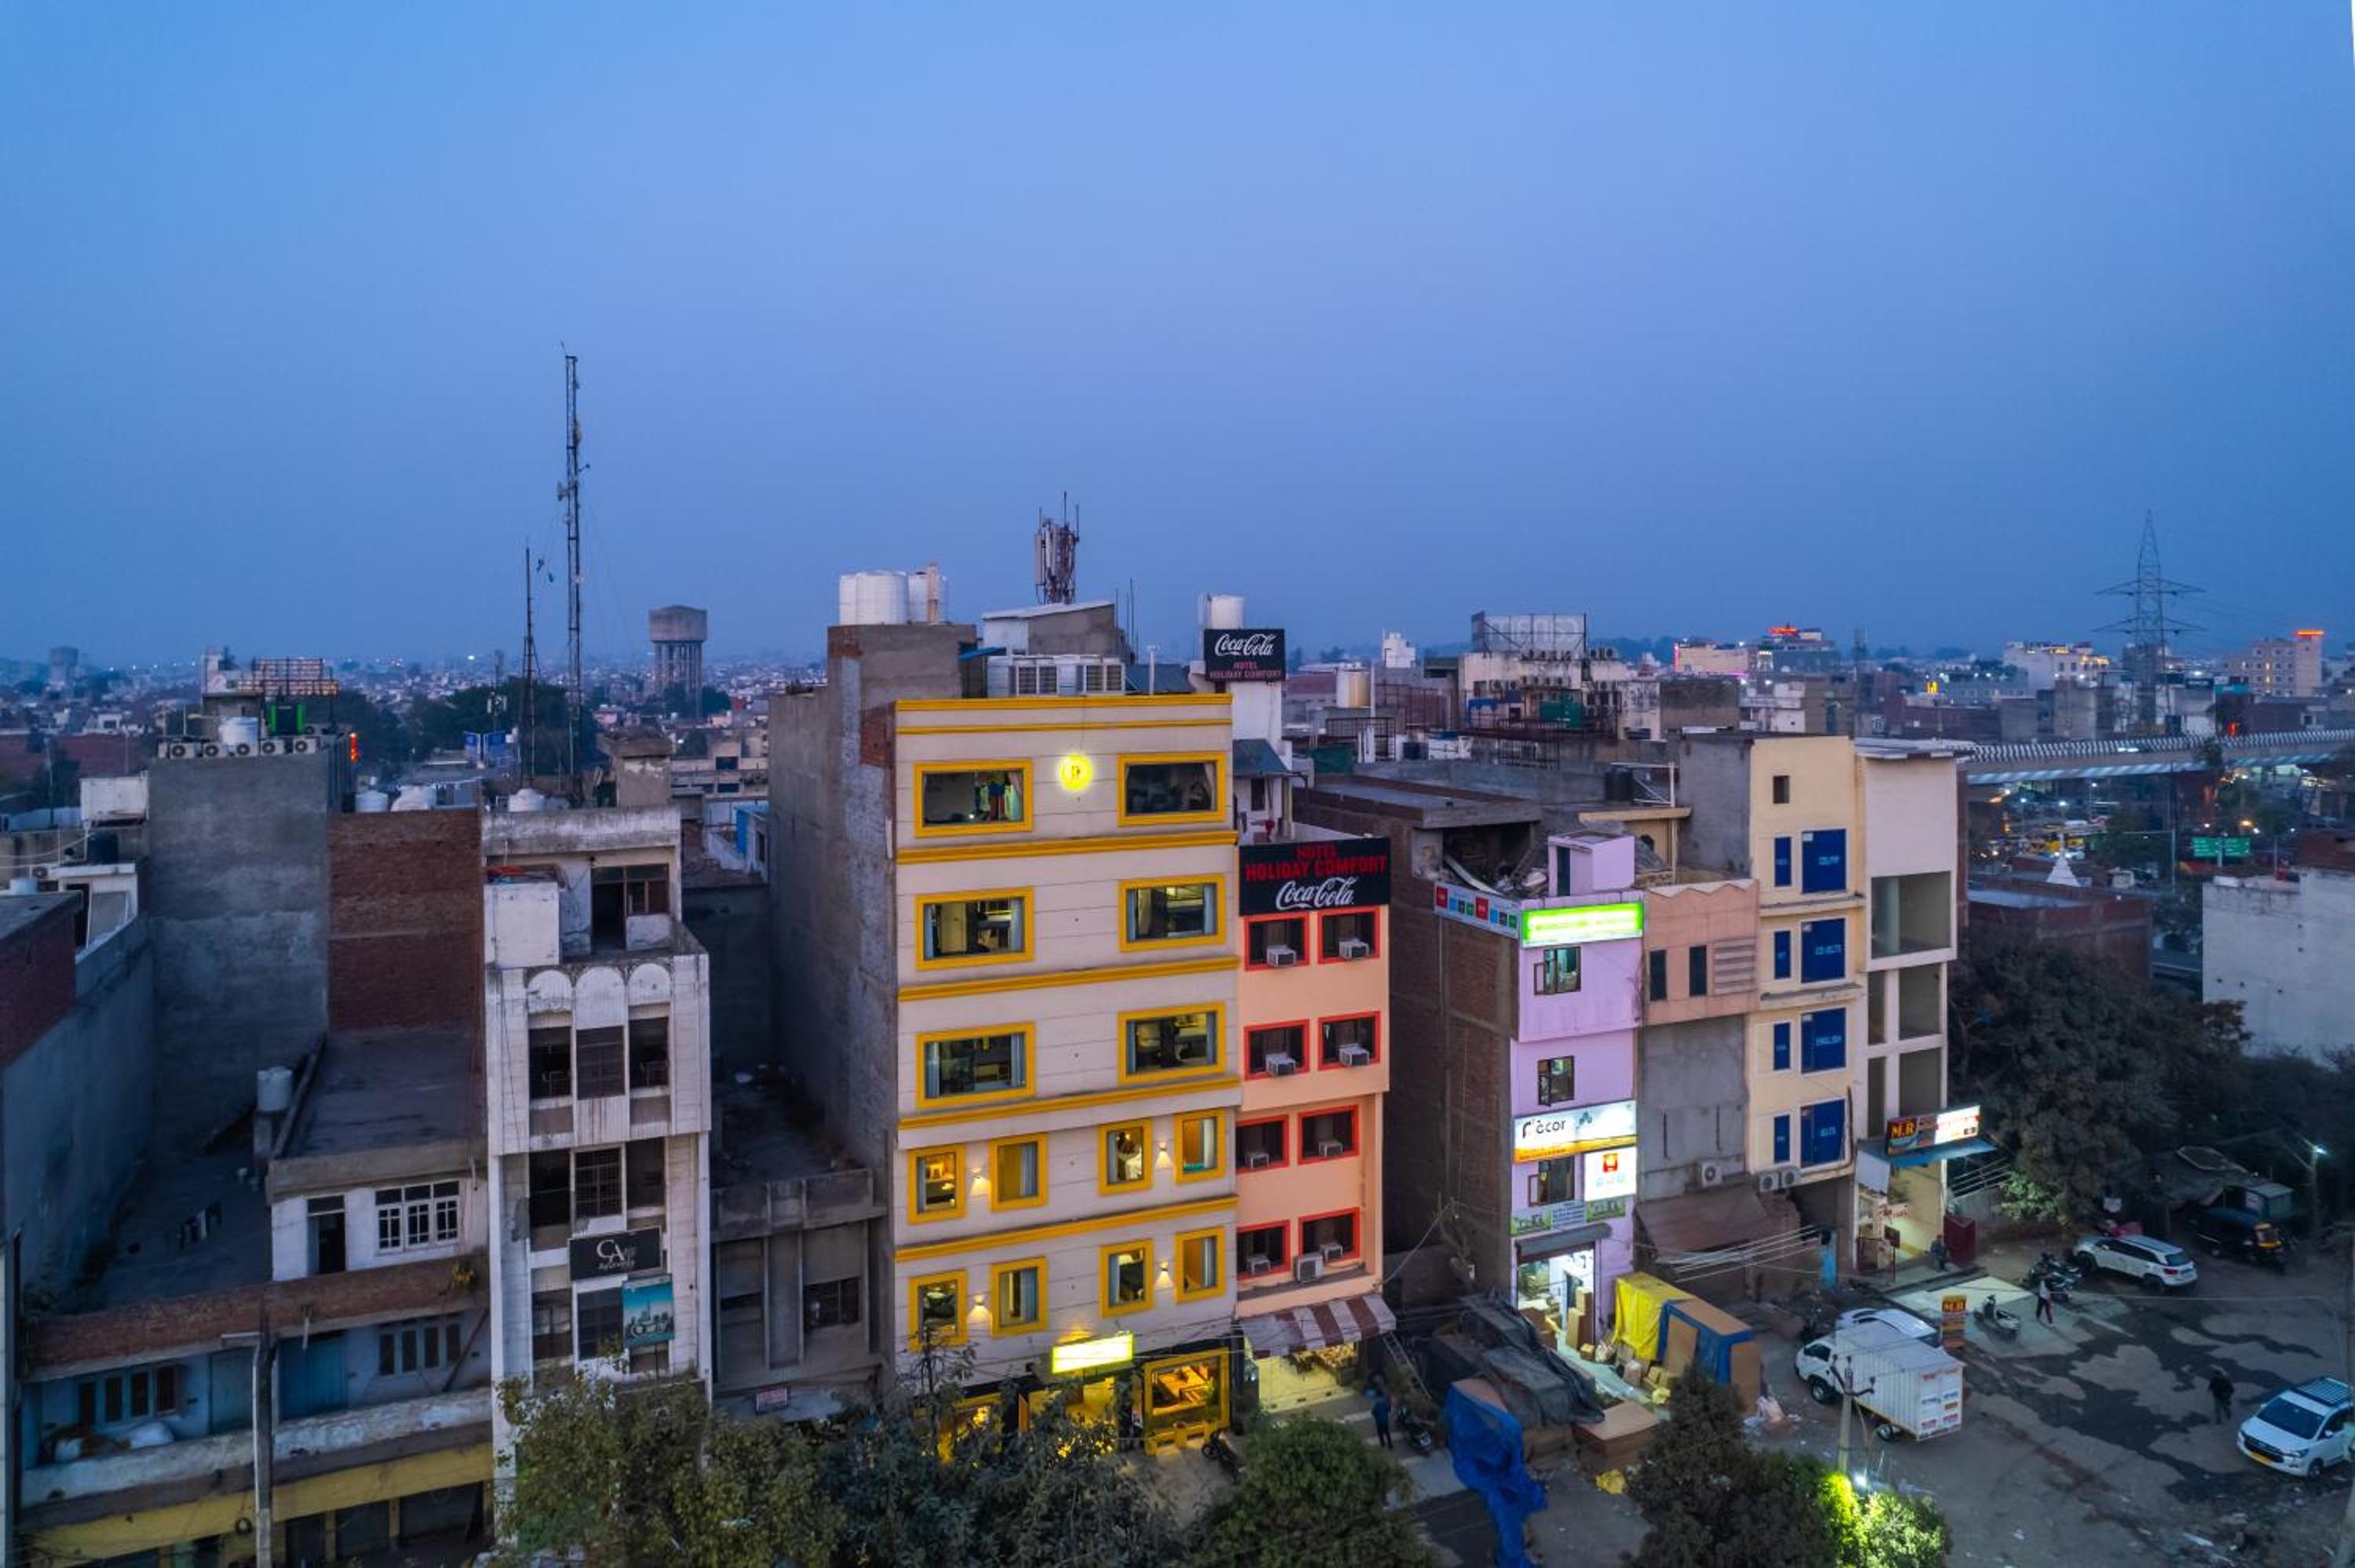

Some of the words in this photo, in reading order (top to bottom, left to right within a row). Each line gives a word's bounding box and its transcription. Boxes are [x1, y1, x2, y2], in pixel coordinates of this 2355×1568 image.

[1214, 633, 1277, 656] Coca-Cola
[1210, 670, 1242, 679] HOLIDAY
[1296, 844, 1337, 859] HOTEL
[1245, 860, 1310, 881] HOLIDAY
[1314, 854, 1387, 877] COMFORT
[1276, 876, 1358, 910] Coca-Cola
